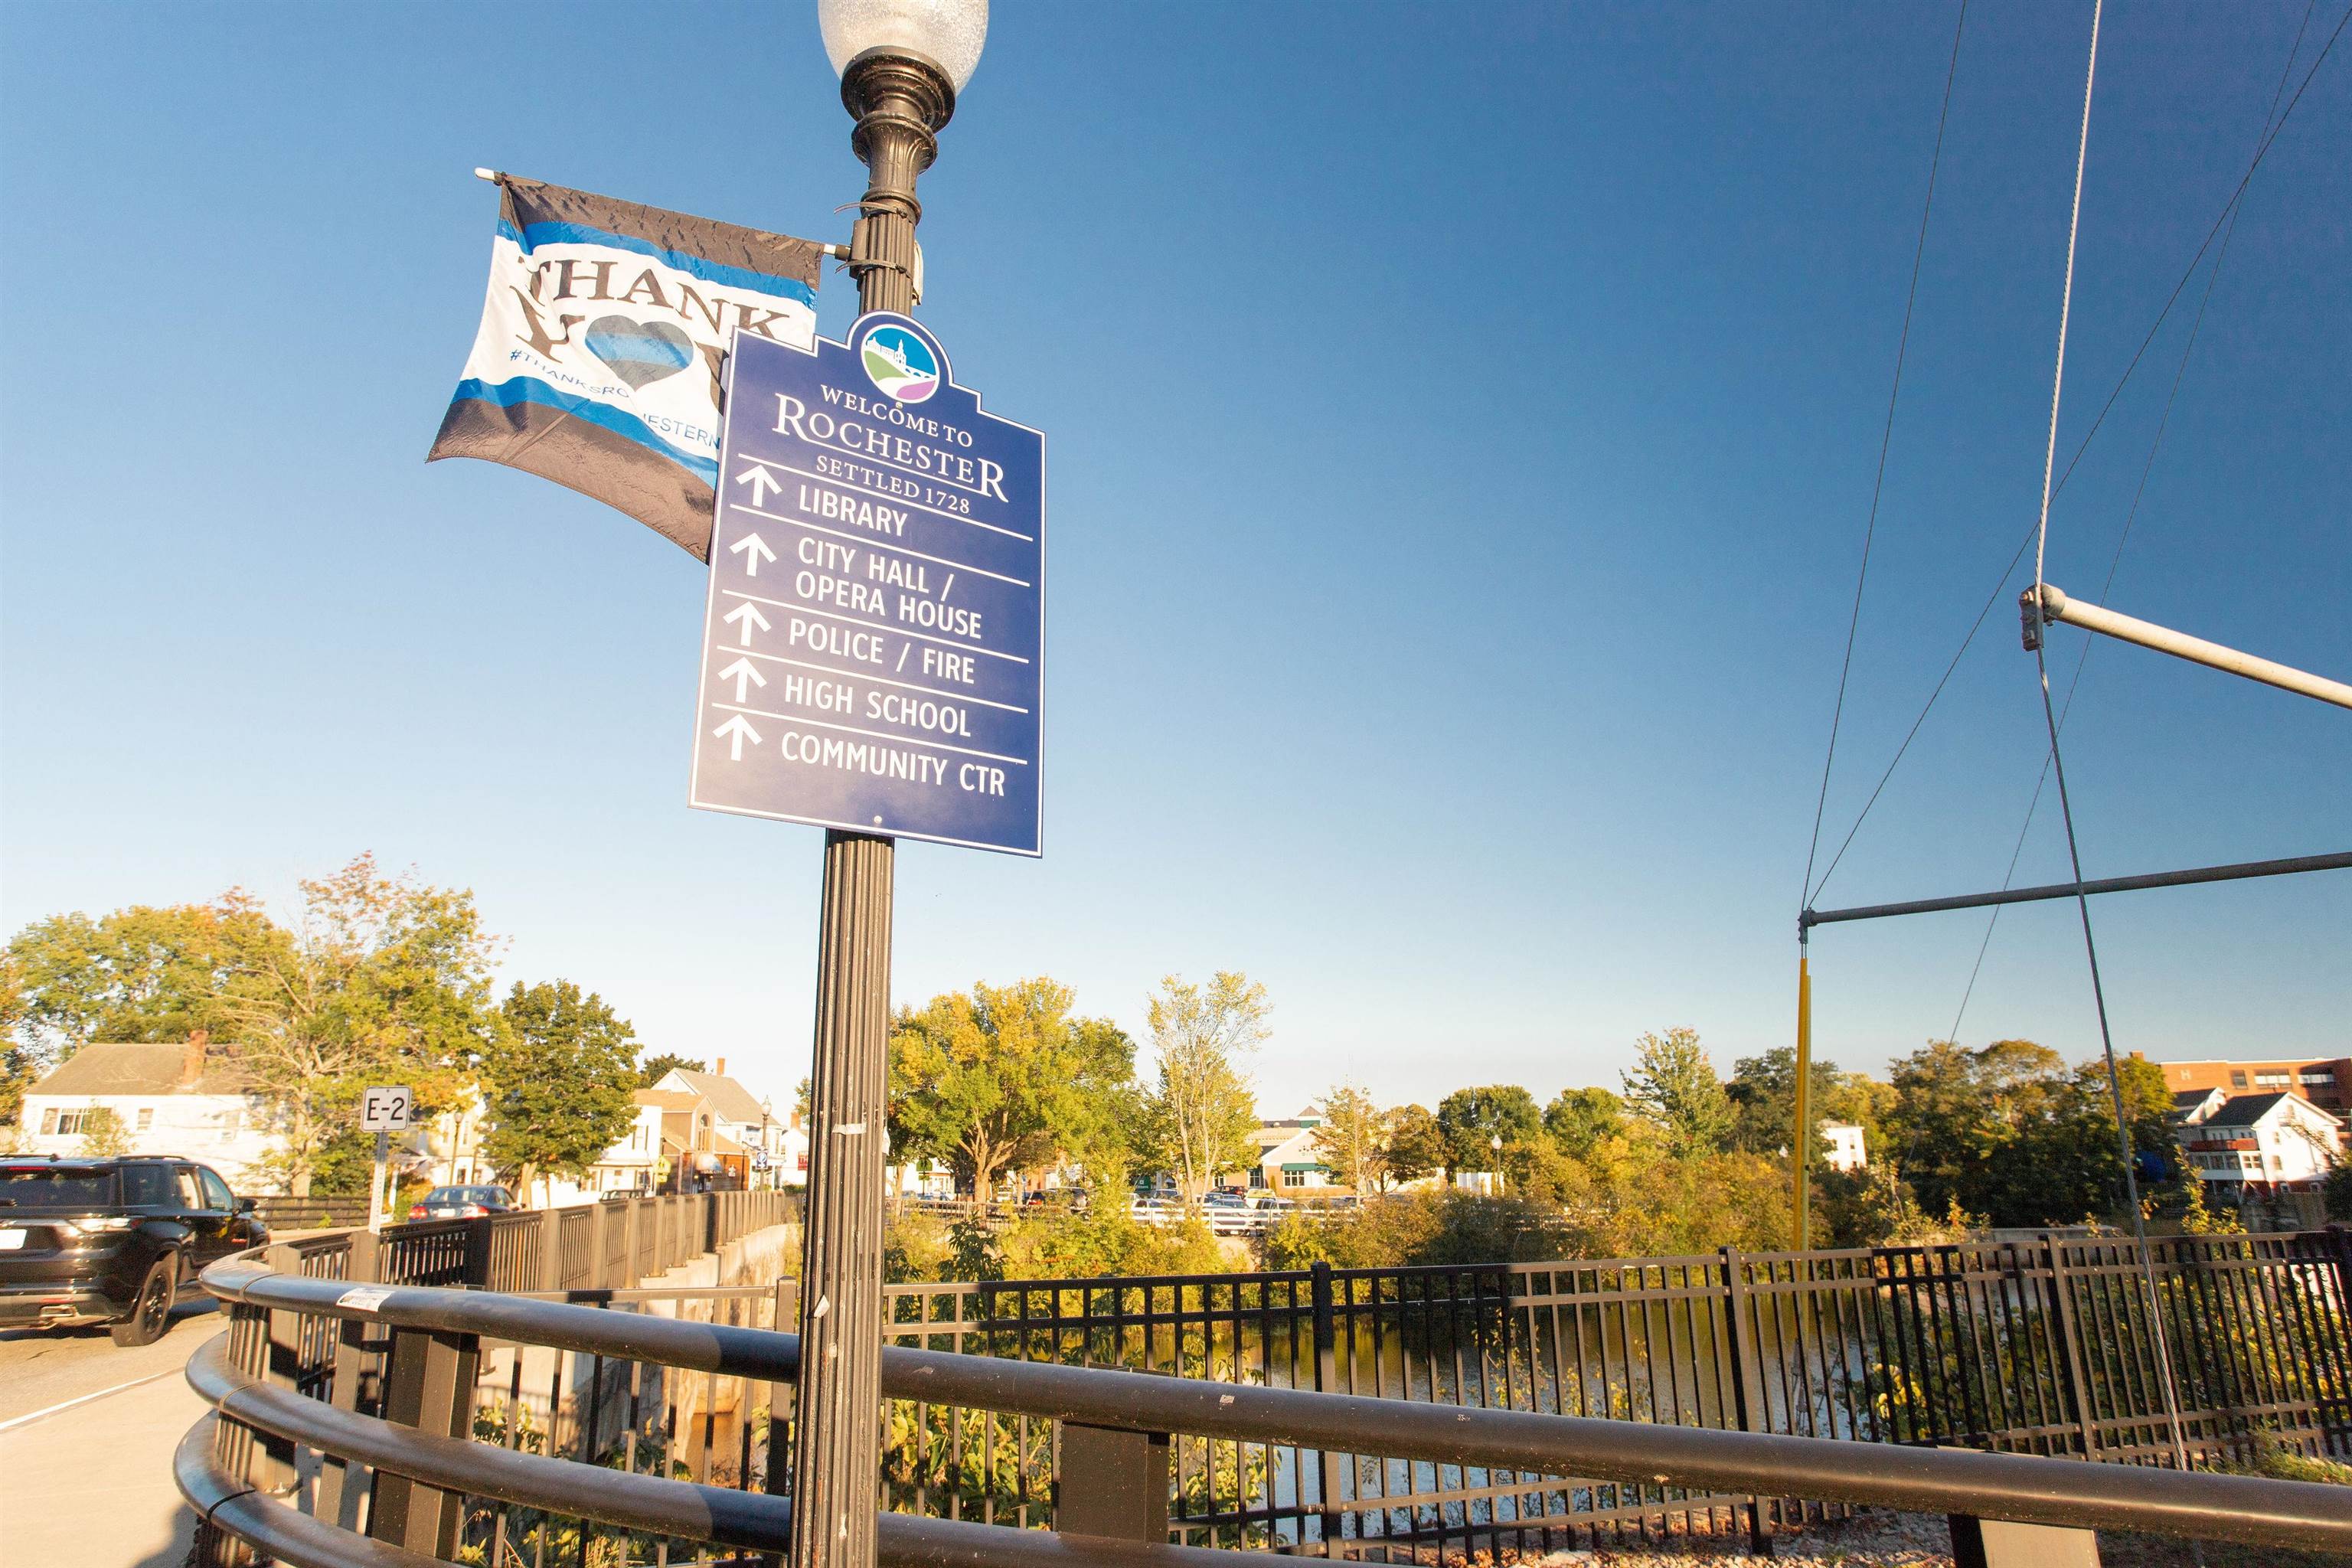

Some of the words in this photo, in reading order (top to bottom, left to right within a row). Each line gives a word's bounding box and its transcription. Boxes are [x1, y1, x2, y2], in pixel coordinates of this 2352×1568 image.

[518, 256, 789, 340] THANK
[772, 393, 1009, 503] ROCHESTER
[820, 384, 938, 437] WELCOME
[943, 426, 973, 448] TO
[799, 485, 908, 536] LIBRARY
[816, 456, 920, 498] SETTLED
[925, 488, 970, 514] 1728
[798, 537, 857, 573] CITY
[868, 553, 929, 593] HALL
[940, 573, 955, 602] /
[795, 570, 886, 616] OPERA
[899, 594, 982, 639] HOUSE
[789, 618, 884, 665] POLICE
[896, 642, 910, 672] /
[923, 647, 975, 684] FIRE
[785, 674, 853, 714] HIGH
[866, 691, 971, 737] SCHOOL
[781, 731, 948, 786] COMMUNITY
[959, 763, 1004, 797] CTR
[367, 1096, 405, 1122] E-2
